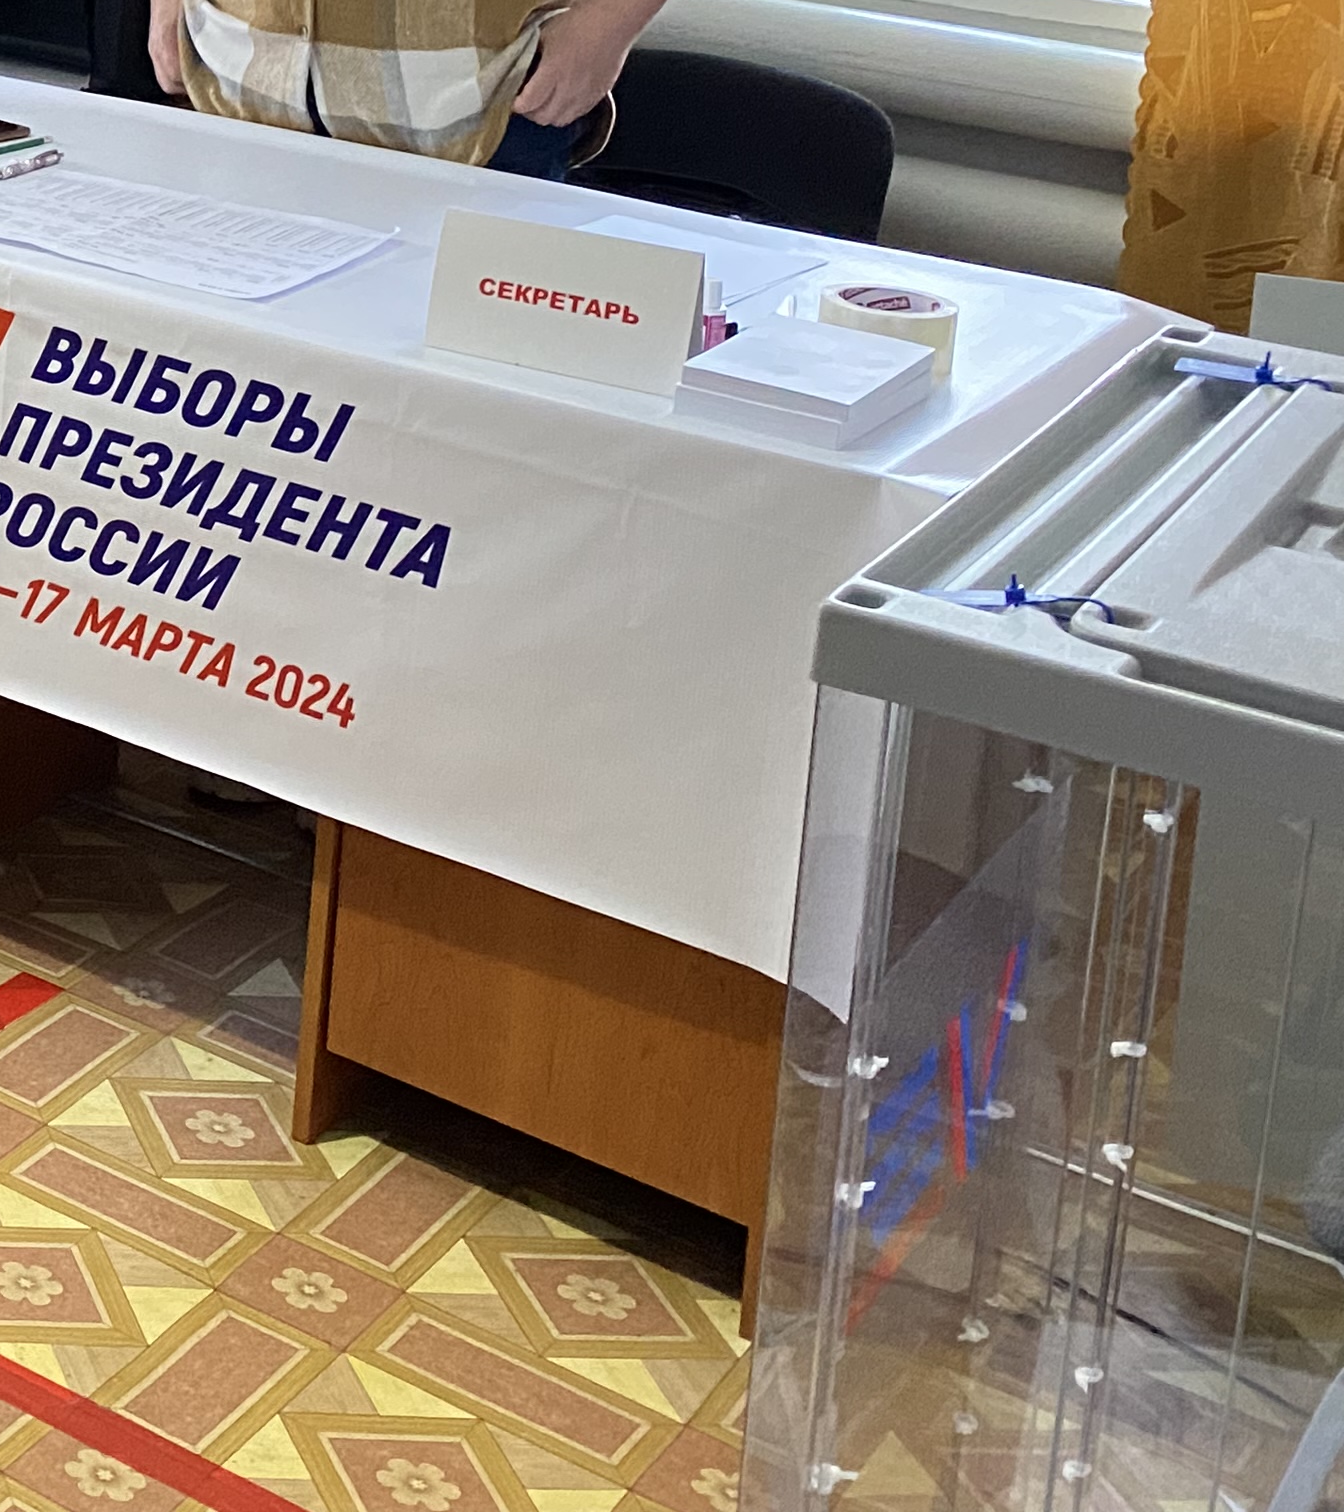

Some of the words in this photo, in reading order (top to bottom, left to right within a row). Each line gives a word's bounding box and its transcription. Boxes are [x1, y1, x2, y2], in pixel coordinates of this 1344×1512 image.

[479, 278, 640, 325] СЕКРЕТАРЬ
[31, 326, 355, 463] ВЫБОРЫ
[73, 597, 236, 688] МАРТА
[245, 654, 356, 729] 2024
